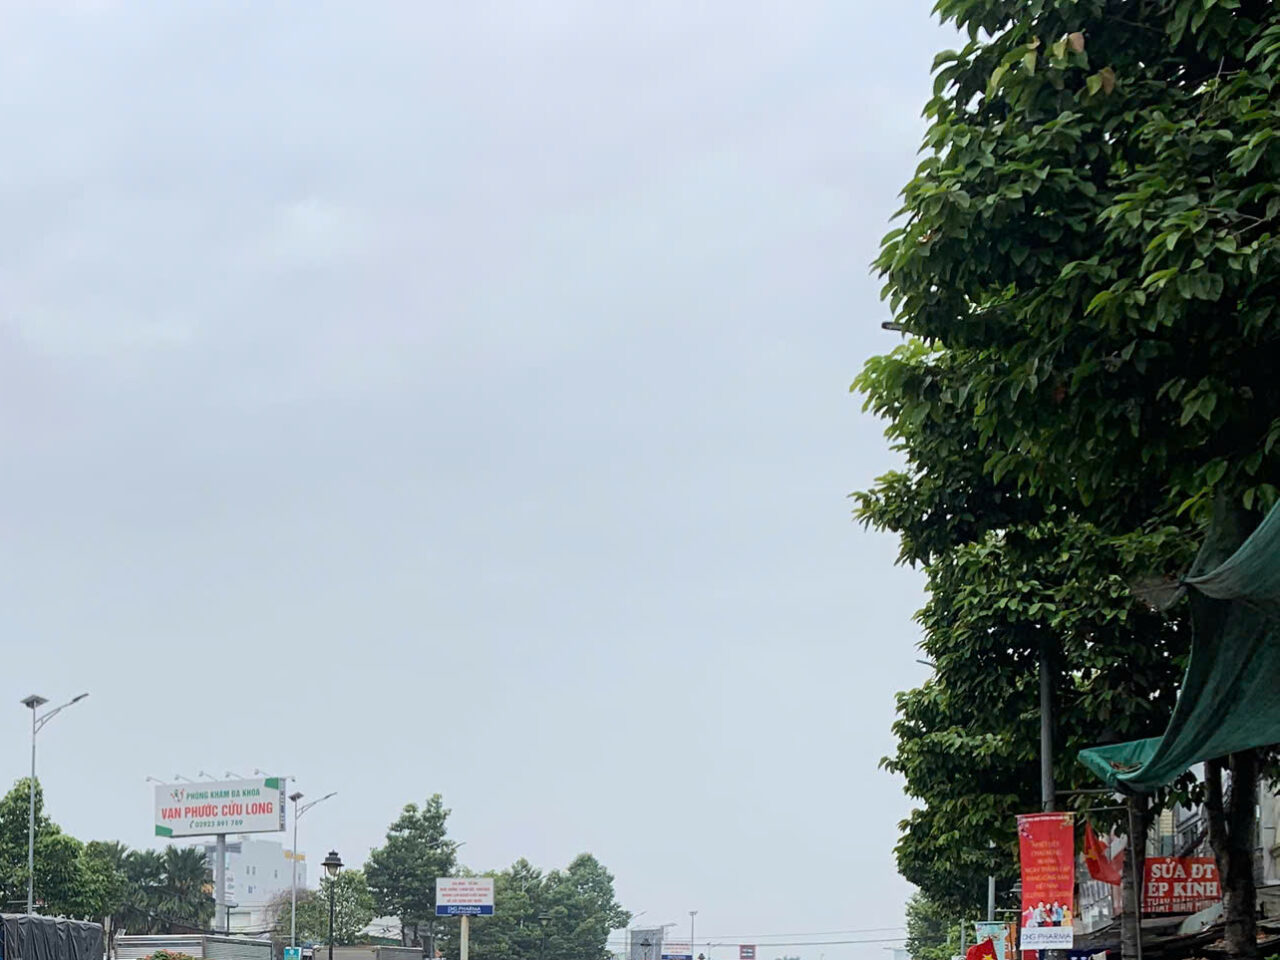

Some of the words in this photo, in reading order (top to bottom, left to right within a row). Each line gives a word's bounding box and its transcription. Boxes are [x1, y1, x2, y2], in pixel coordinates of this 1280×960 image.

[245, 802, 273, 816] LONG
[1151, 858, 1187, 879] SỬA
[1191, 863, 1216, 879] ĐT
[1147, 878, 1169, 897] ÉP
[1173, 878, 1219, 896] KÍNH
[1038, 932, 1072, 941] PHARMA
